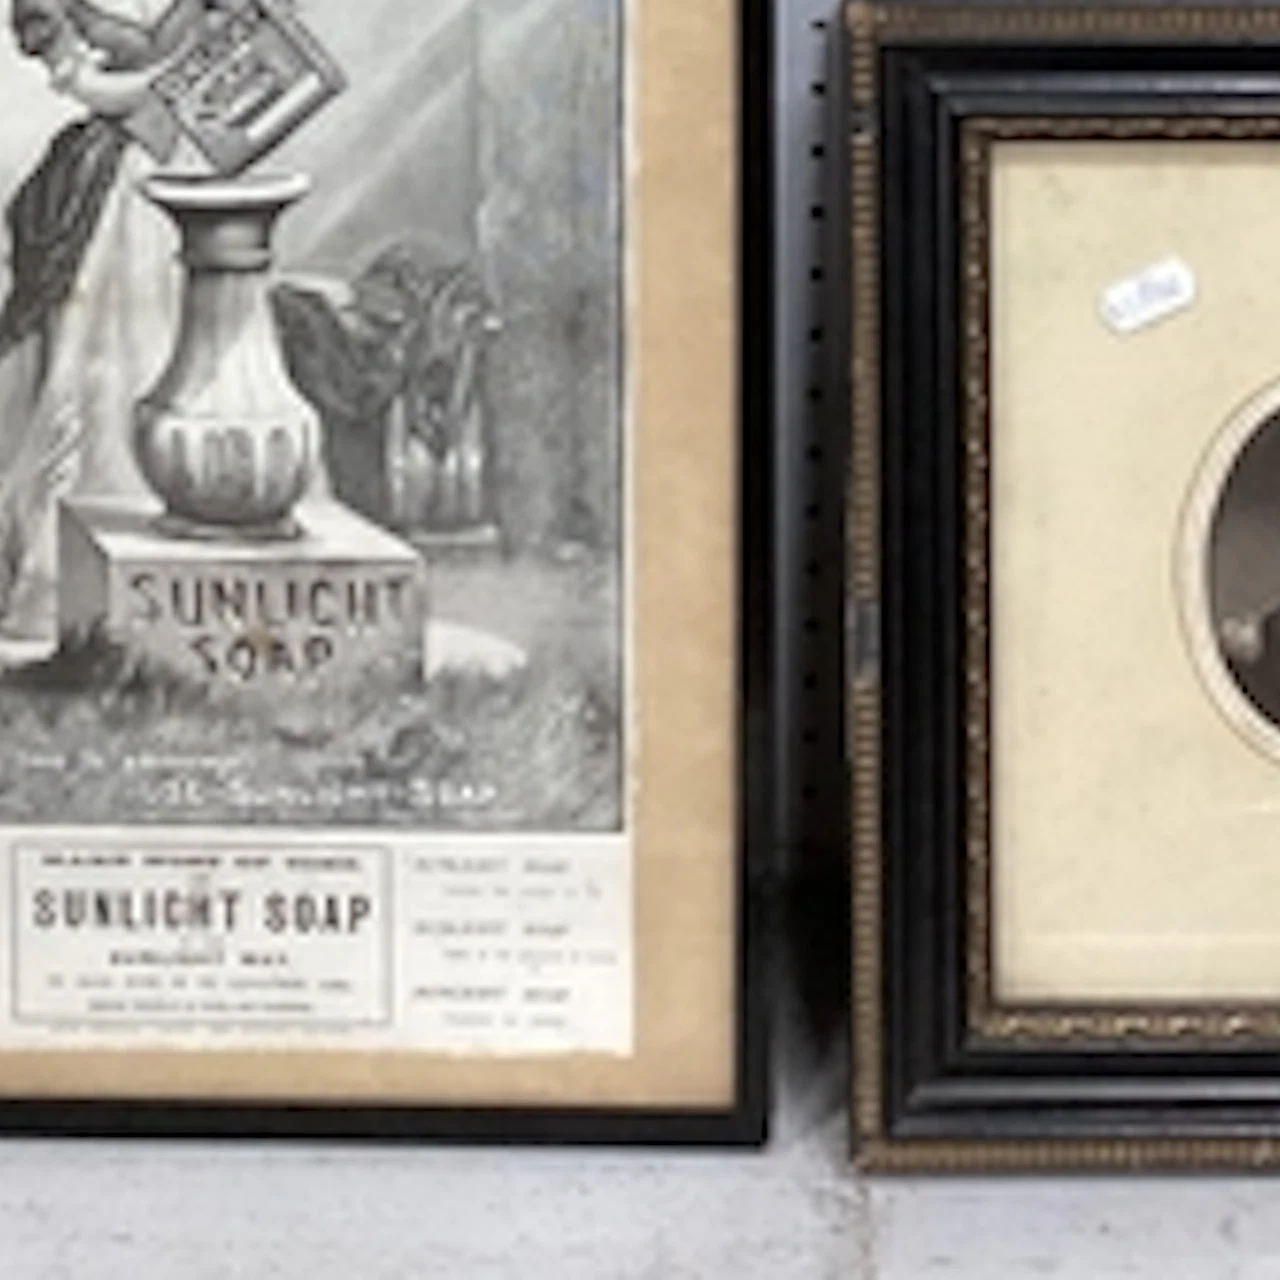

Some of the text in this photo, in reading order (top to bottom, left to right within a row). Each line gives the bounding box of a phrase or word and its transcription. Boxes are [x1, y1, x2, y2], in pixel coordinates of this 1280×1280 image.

[128, 572, 412, 632] SUNLIGHT
[190, 634, 334, 683] SOAP
[32, 887, 372, 935] SUNLIGHT SOAP
